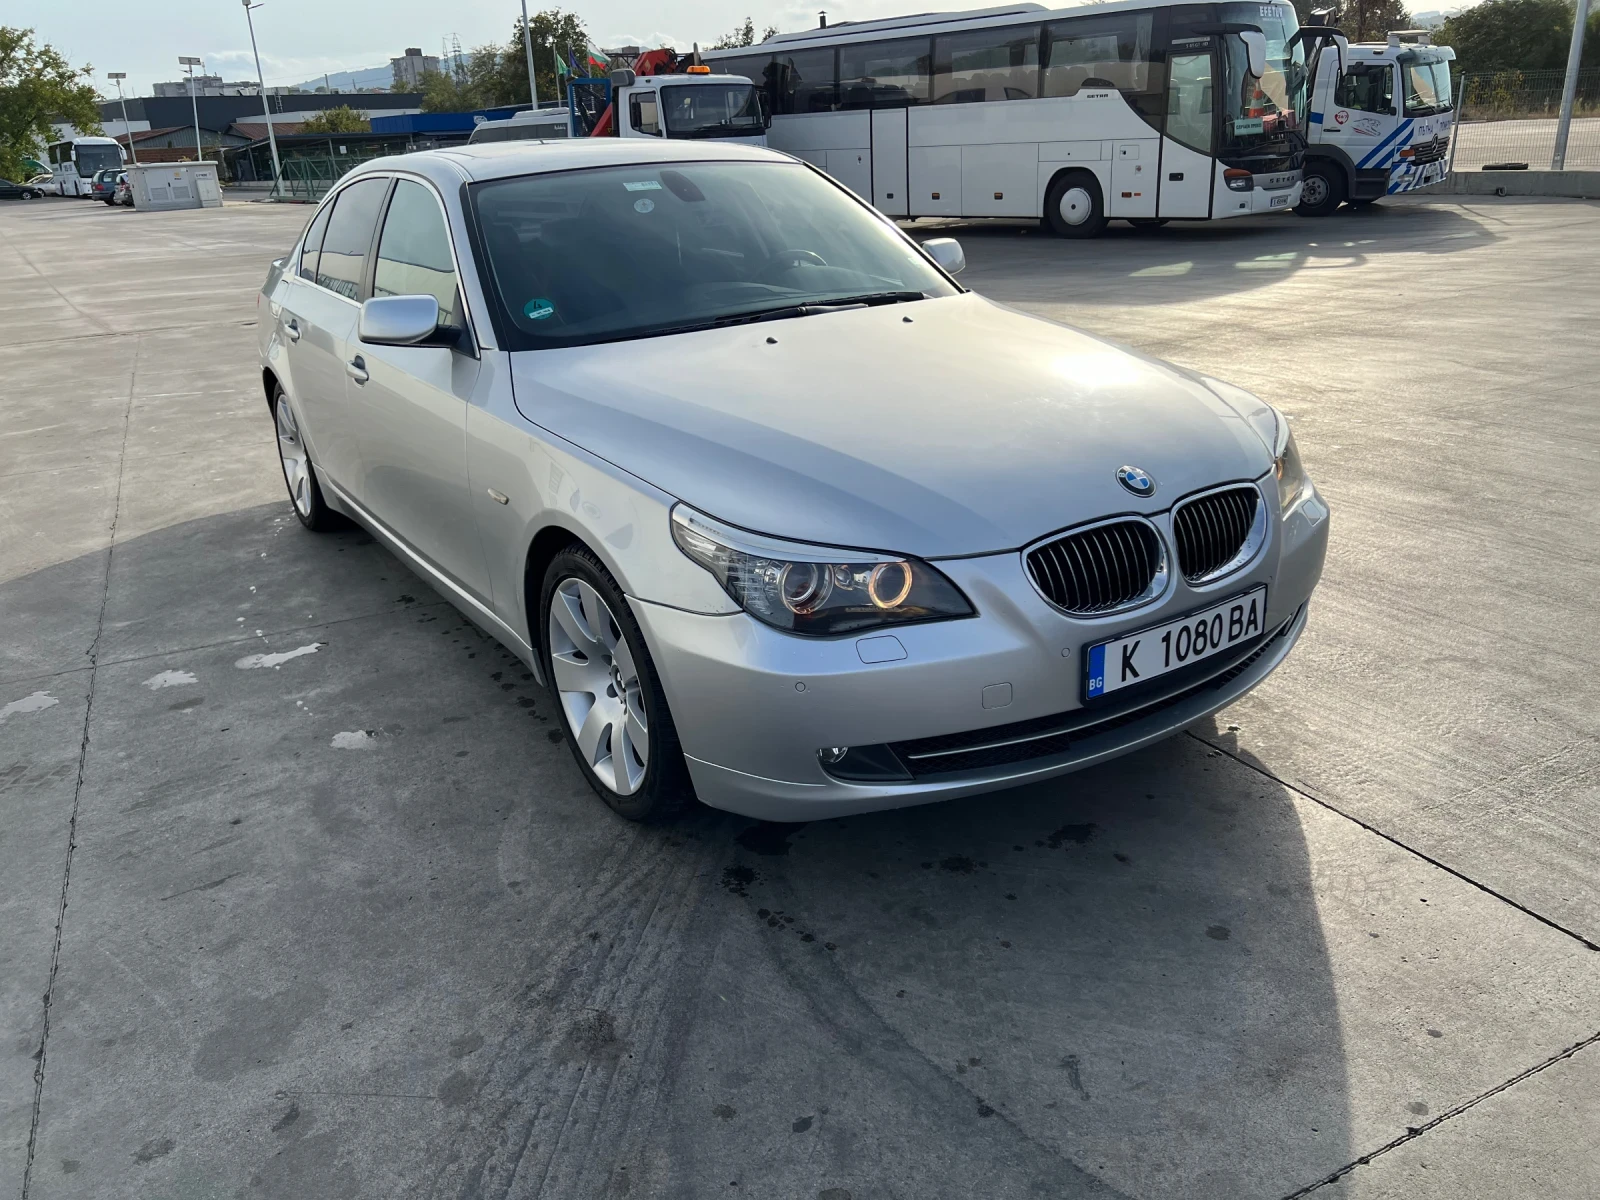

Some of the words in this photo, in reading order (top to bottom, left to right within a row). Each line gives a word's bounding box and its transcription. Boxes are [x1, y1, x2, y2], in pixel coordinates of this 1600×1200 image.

[1269, 175, 1295, 184] SETRA
[1121, 639, 1141, 682] K
[1089, 677, 1103, 691] BG
